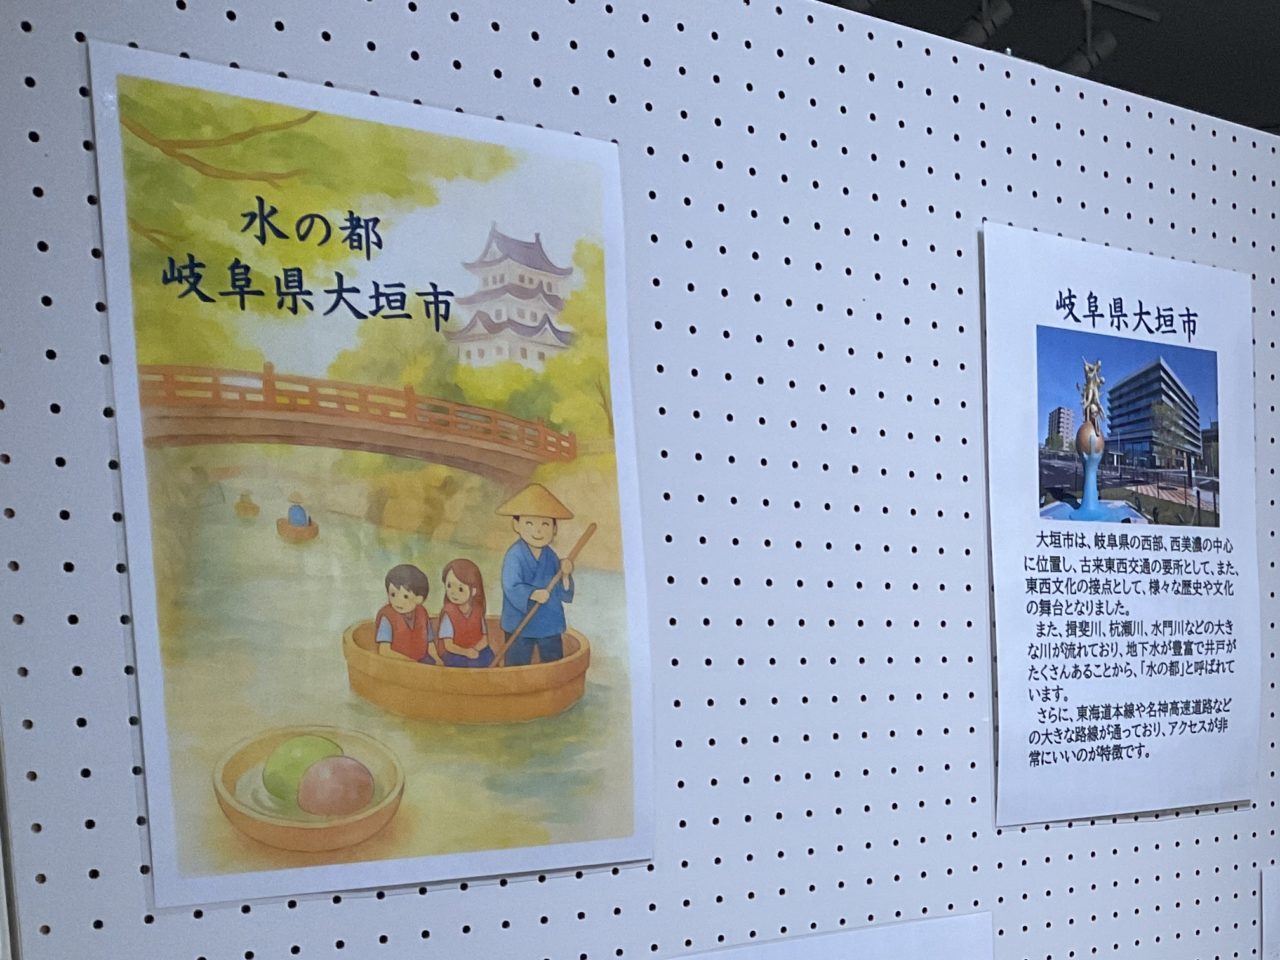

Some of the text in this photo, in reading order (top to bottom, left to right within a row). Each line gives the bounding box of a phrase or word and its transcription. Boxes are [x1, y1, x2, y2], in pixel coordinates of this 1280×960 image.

[240, 195, 383, 261] 水の都
[161, 253, 456, 333] 岐阜県大垣市
[1055, 287, 1199, 343] 岐阜県大垣市
[1035, 530, 1234, 554] 大垣市は、岐阜県の西部、西美濃の中心
[1023, 555, 1240, 577] に位置し、古来東西交通の要所として、また、
[1025, 576, 1235, 597] 東西文化の接点として、様々な歴史や文化
[1026, 599, 1130, 617] の舞台となりました。
[1035, 619, 1234, 639] また、揖斐川、杭瀬川、水門川などの大き
[1027, 639, 1237, 660] な川が流れており、地下水が豊富で井戸が
[1027, 659, 1236, 682] たくさんあることから、「水の都」と呼ばれて
[1028, 685, 1069, 703] います。
[1036, 697, 1233, 725] さらに、東海道本線や名神高速道路など
[1028, 717, 1229, 746] の大きな路線が通っており、アクセスが非
[1028, 743, 1150, 768] 常にいいのが特徴です。
